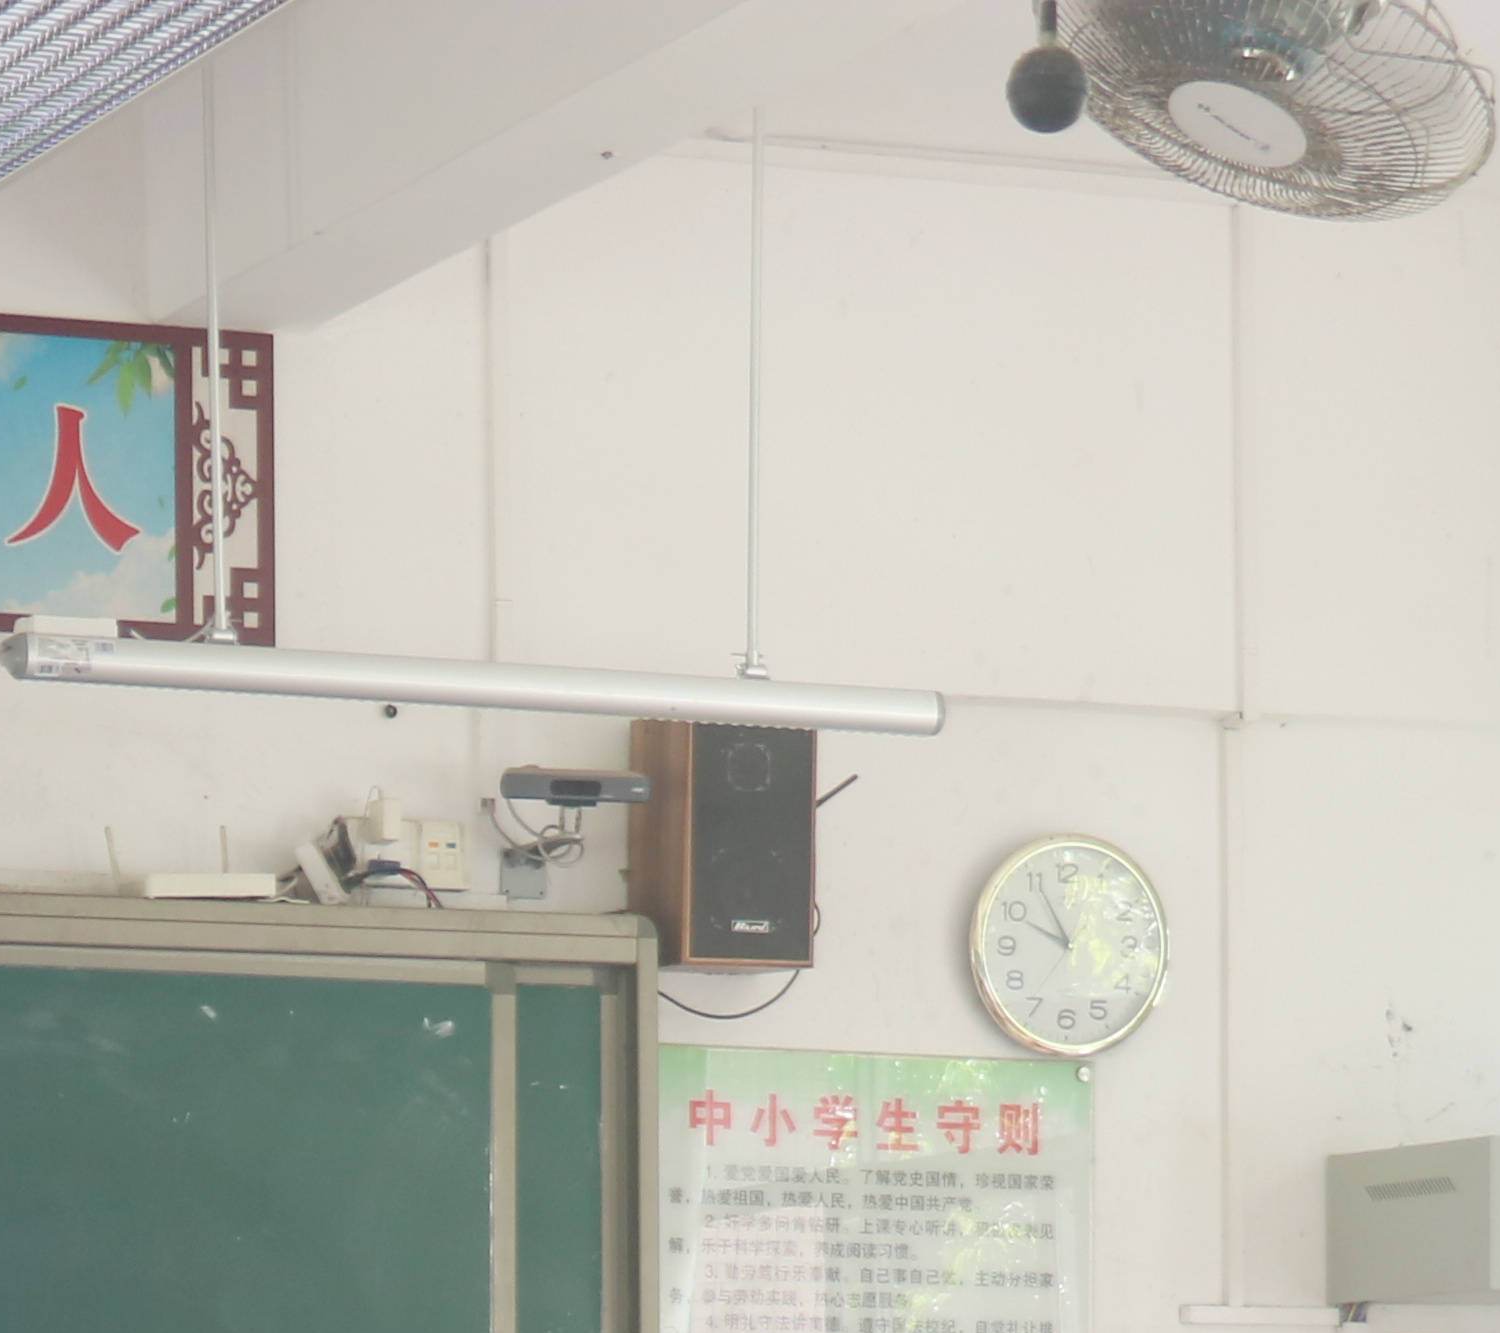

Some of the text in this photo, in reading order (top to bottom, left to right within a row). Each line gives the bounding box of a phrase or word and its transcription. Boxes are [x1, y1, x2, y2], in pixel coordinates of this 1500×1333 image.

[1027, 872, 1043, 892] 11
[1056, 862, 1079, 883] 12
[1002, 900, 1027, 922] 10
[1116, 901, 1133, 922] 2
[997, 935, 1016, 956] 9
[1120, 936, 1138, 959] 3
[1006, 970, 1024, 990] 8
[1113, 974, 1132, 994] 4
[1025, 997, 1044, 1018] 7
[1089, 1000, 1108, 1021] 5
[1057, 1009, 1076, 1030] 6
[688, 1089, 1042, 1156] 中小学生守则
